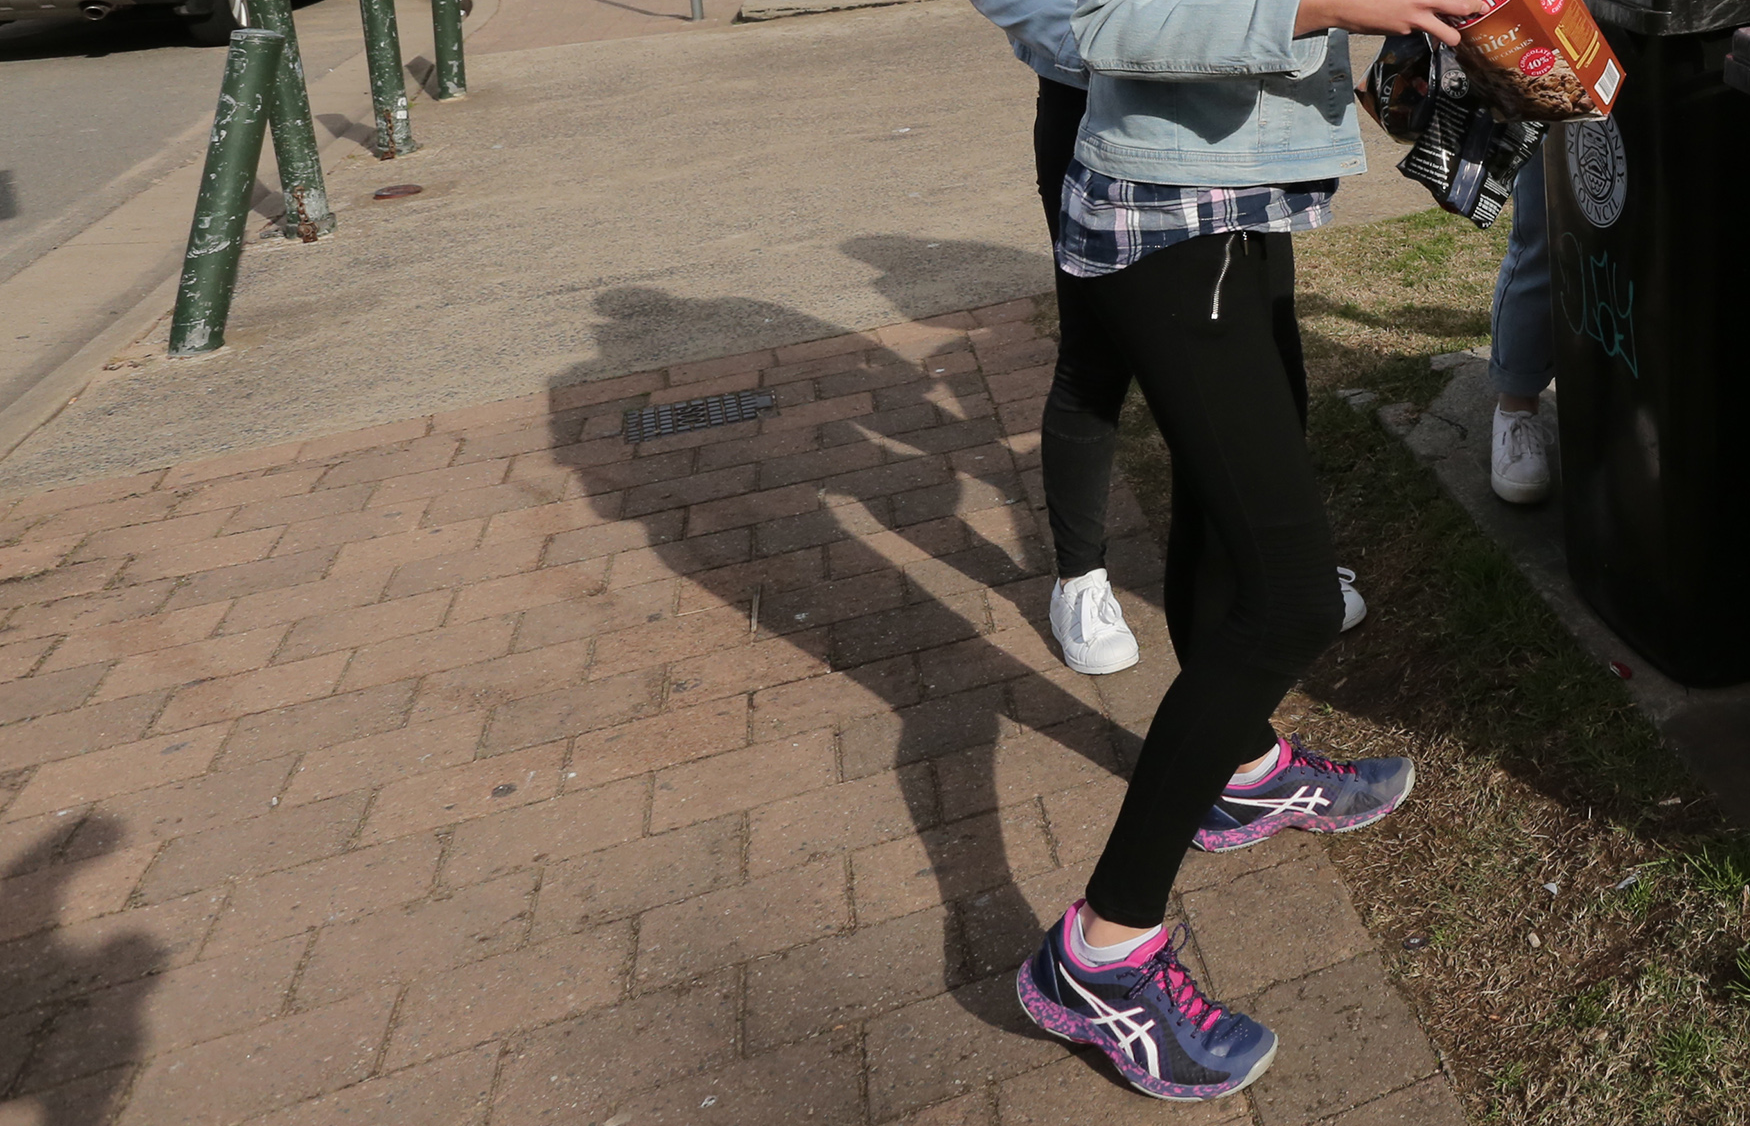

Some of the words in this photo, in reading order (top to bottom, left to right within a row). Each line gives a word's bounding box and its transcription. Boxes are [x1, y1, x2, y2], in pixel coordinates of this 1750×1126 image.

[1500, 37, 1534, 58] COOKIES
[1520, 49, 1551, 69] CHOCOLATE
[1526, 54, 1550, 70] 40%
[1531, 65, 1551, 75] CHIPS
[1573, 173, 1620, 221] COUNCIL
